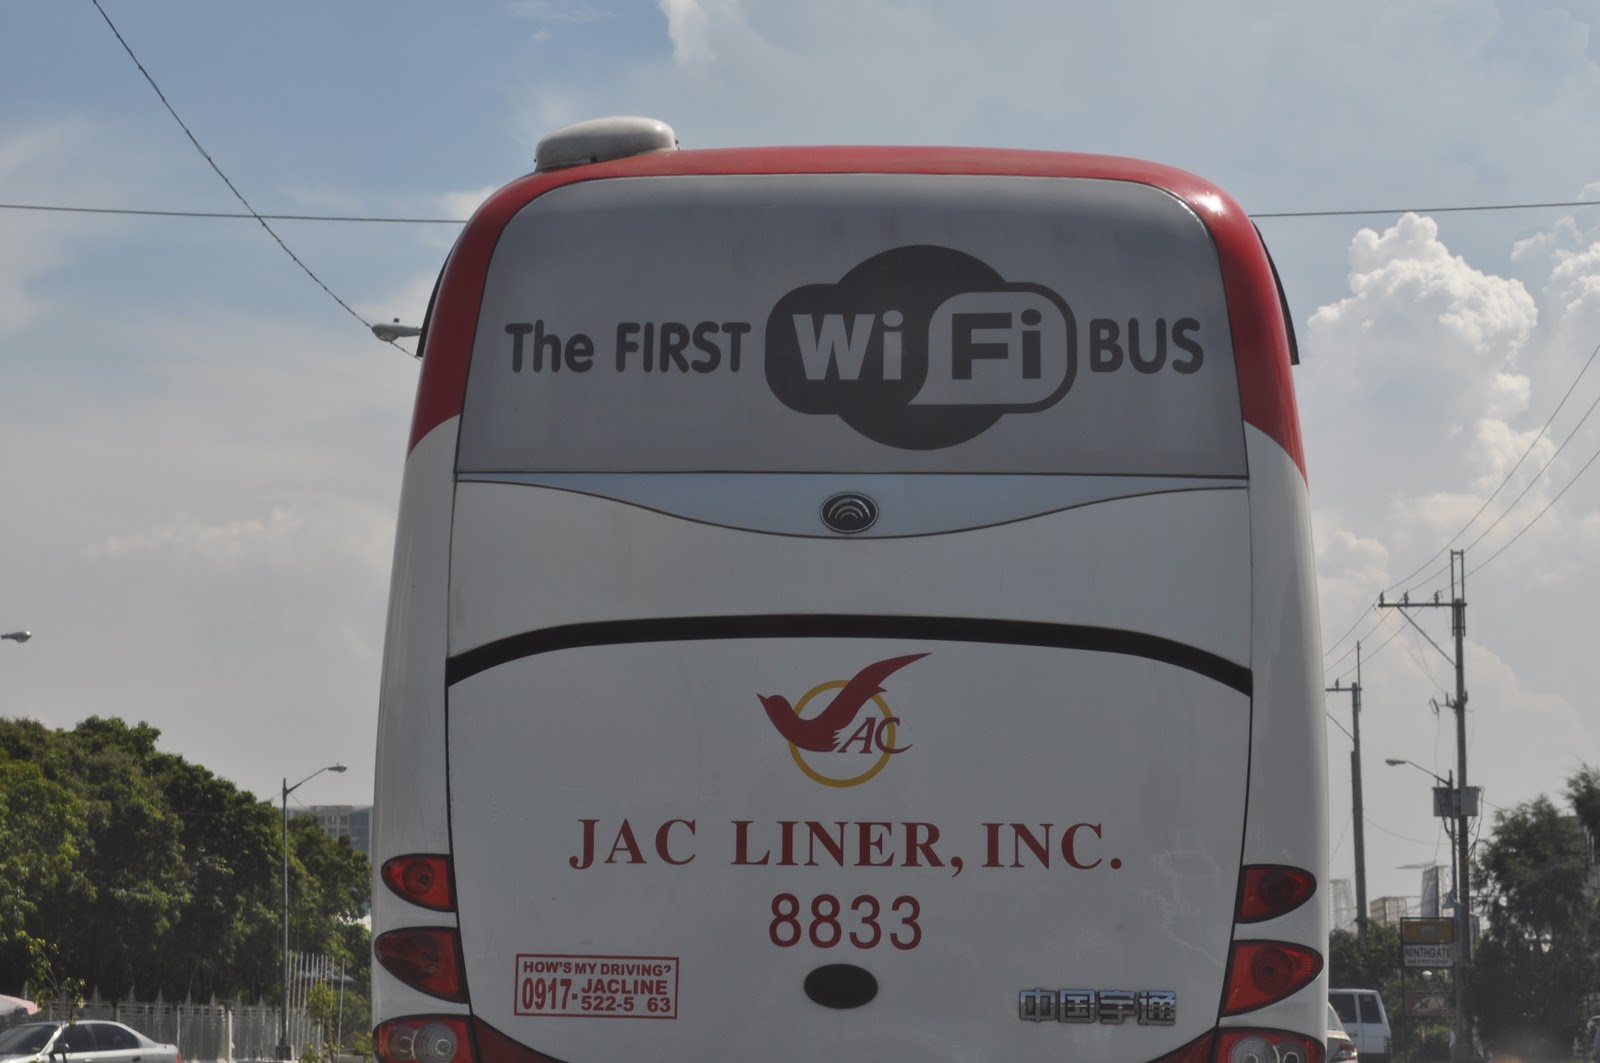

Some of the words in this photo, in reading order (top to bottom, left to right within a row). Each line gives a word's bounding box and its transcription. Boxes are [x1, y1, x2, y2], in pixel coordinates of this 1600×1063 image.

[505, 319, 595, 374] The
[615, 321, 752, 374] FIRST
[1089, 317, 1204, 374] BUS
[569, 818, 697, 870] JAC
[730, 820, 964, 878] LINER,
[980, 822, 1122, 870] INC.
[769, 892, 922, 950] 8833
[523, 961, 572, 974] HOW'S
[575, 963, 597, 974] MY
[600, 963, 671, 977] DRIVING?
[581, 978, 668, 996] JACLINE
[1018, 988, 1176, 1026] 中国宇通
